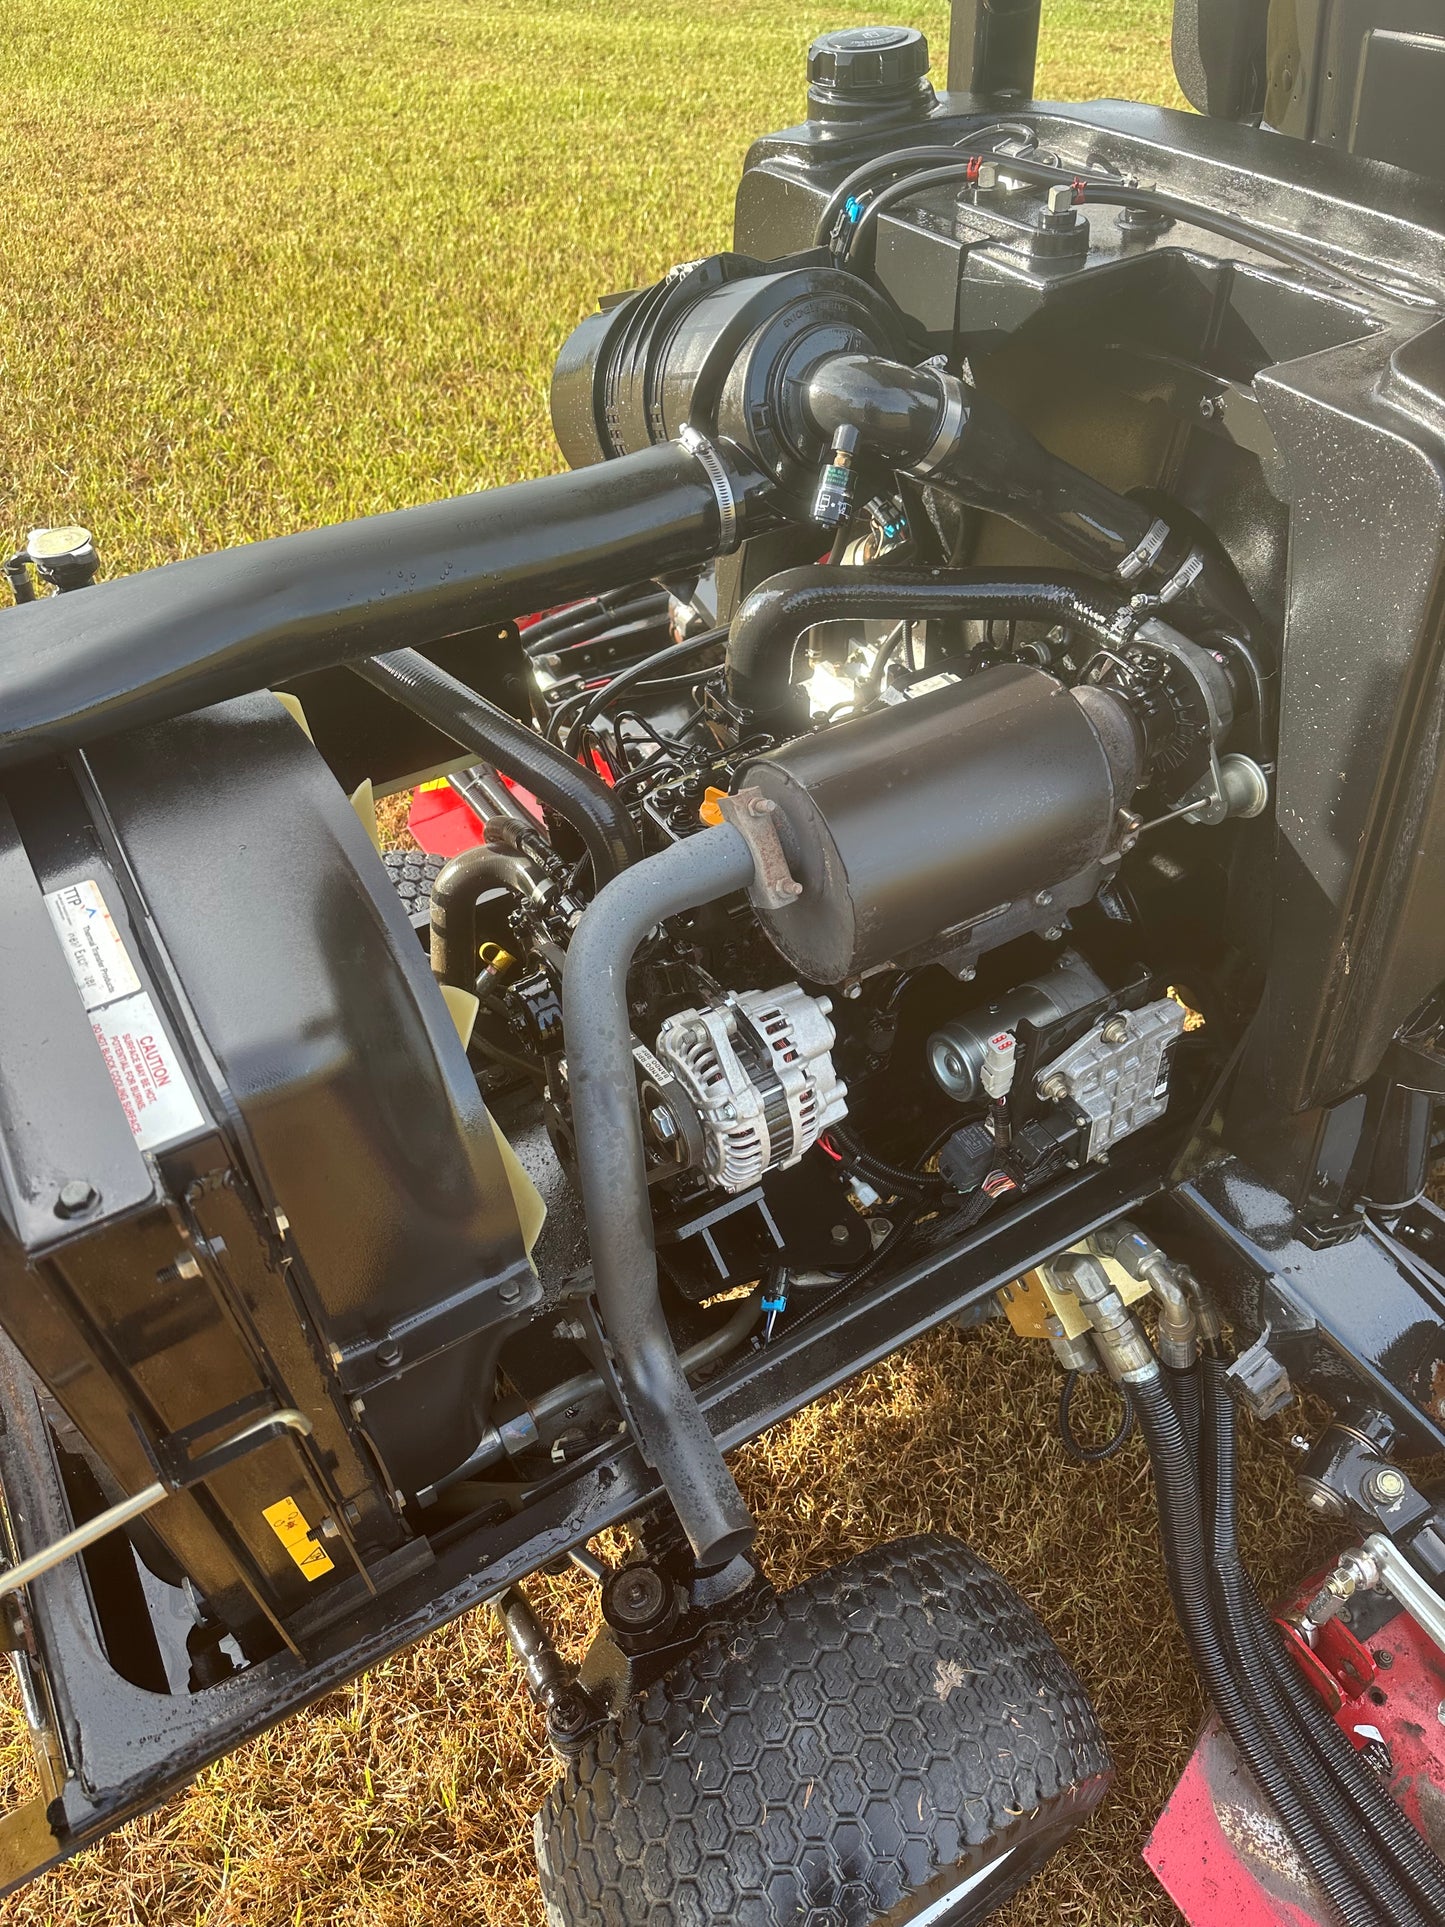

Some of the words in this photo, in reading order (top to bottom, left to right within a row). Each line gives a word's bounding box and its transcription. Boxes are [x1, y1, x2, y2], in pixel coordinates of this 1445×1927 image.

[63, 886, 83, 908] TTP
[82, 925, 98, 948] Thermal
[91, 946, 106, 969] Transfer
[100, 967, 117, 994] Products
[92, 1023, 103, 1034] DO
[97, 1033, 108, 1048] NOT
[102, 1047, 117, 1071] BLOCK
[110, 1035, 130, 1071] POTENTIAL
[124, 1070, 137, 1086] FOR
[121, 1033, 141, 1064] SURFACE
[133, 1062, 146, 1078] MAY
[140, 1077, 151, 1088] BE
[139, 1034, 172, 1087] CAUTION
[652, 1058, 669, 1081] BANDO
[645, 1061, 664, 1082] BANDO
[109, 1070, 130, 1102] COOLING
